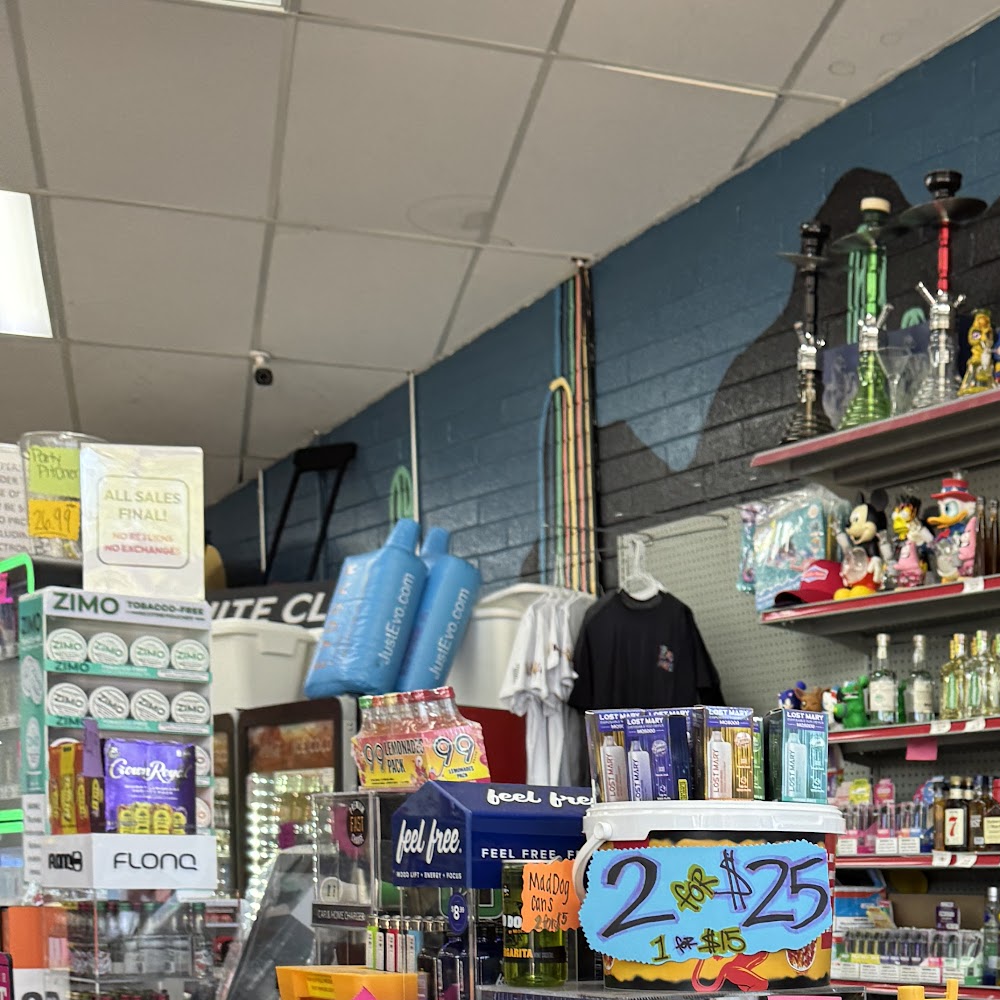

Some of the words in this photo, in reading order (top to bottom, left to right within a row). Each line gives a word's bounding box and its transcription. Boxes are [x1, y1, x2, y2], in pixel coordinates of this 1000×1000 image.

[104, 488, 132, 502] ALL
[135, 490, 181, 505] SALES
[118, 508, 168, 523] FINAL!
[52, 591, 119, 615] ZIMO
[126, 600, 204, 615] TOBACCO-FREE
[54, 660, 90, 673] ZIMO
[177, 705, 206, 715] ZIMO
[729, 709, 749, 717] MARY
[787, 711, 805, 719] LOST
[806, 712, 825, 721] MARY
[627, 718, 645, 726] LOST
[645, 717, 664, 726] MARY
[363, 743, 385, 774] 99
[384, 738, 424, 754] LEMONADES
[432, 733, 475, 767] 99
[110, 758, 151, 779] Crown
[387, 758, 406, 774] PACK
[487, 788, 542, 805] feel
[395, 818, 425, 864] feel
[481, 848, 515, 859] FEEL
[528, 872, 552, 892] Mad
[552, 872, 570, 906] Dog
[601, 856, 677, 939] 2
[712, 849, 829, 931] $25
[531, 894, 553, 913] cans
[651, 935, 669, 962] 1
[697, 929, 747, 954] $15
